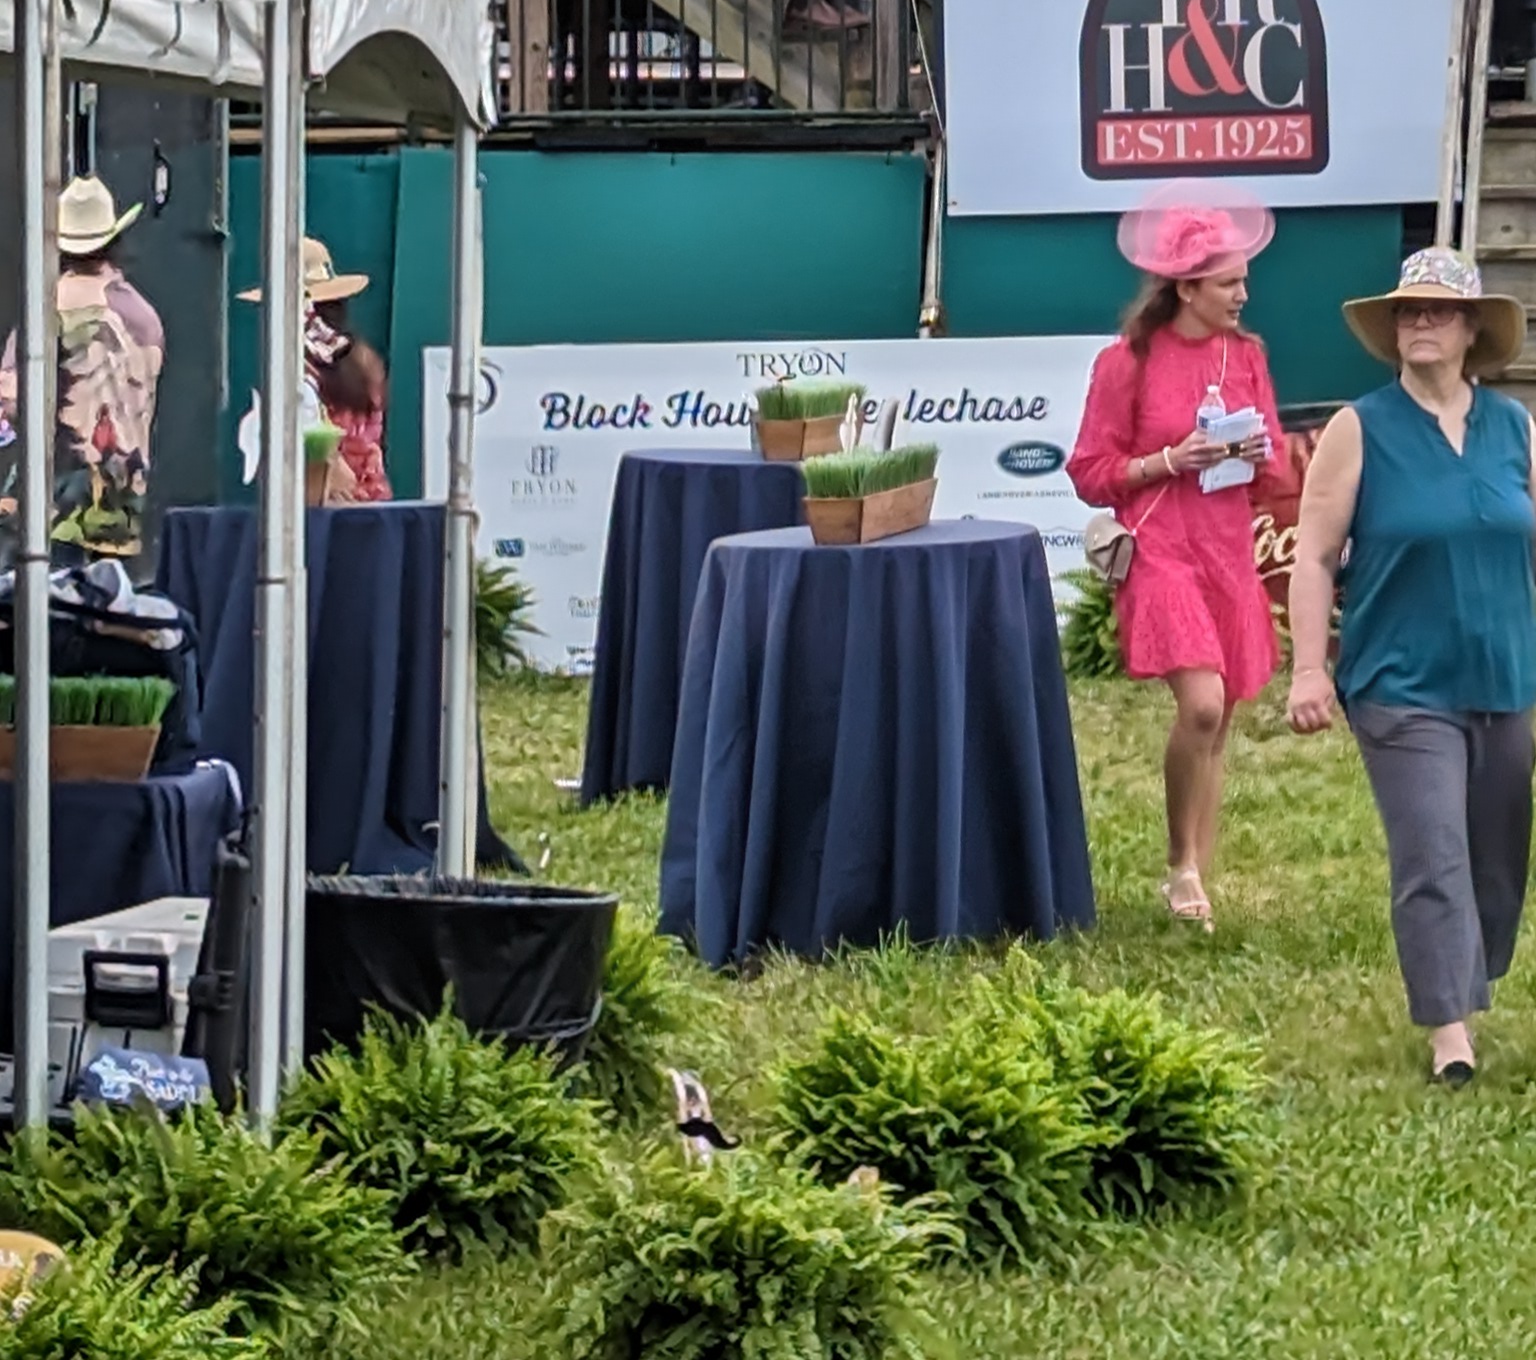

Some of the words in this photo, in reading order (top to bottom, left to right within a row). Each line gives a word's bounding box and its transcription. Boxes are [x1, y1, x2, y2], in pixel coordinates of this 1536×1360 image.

[736, 349, 846, 378] TRYON
[540, 390, 654, 432] Block
[661, 390, 751, 429] Hou
